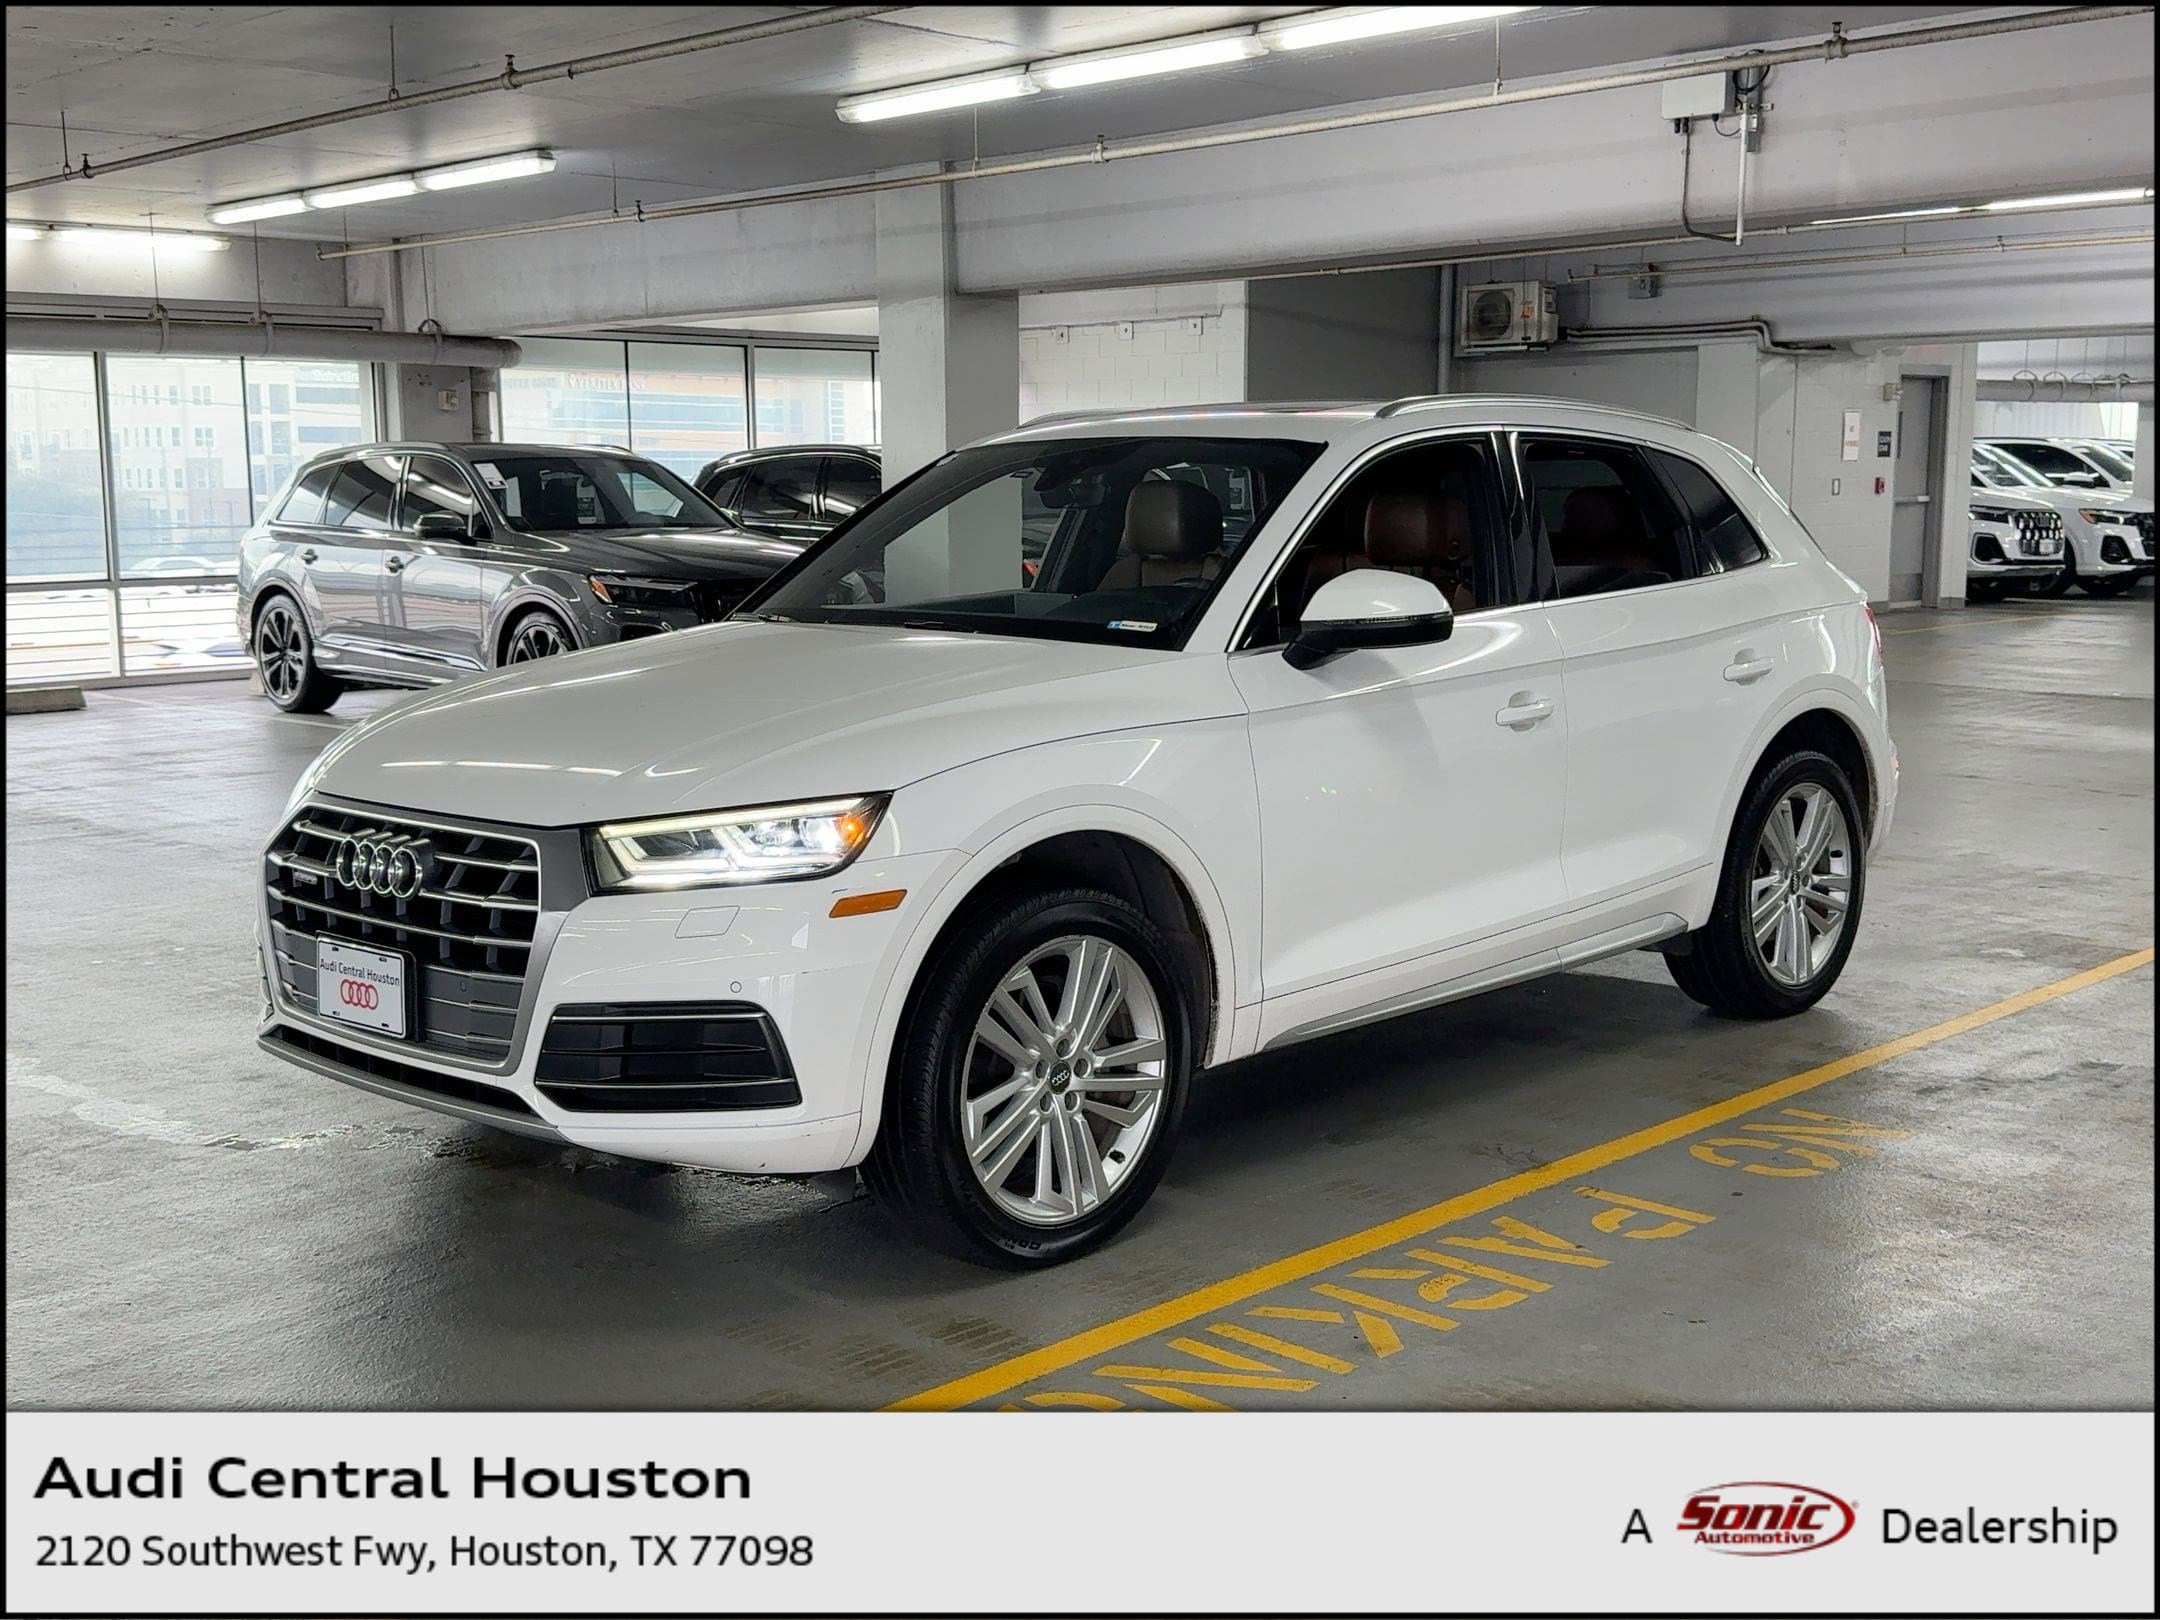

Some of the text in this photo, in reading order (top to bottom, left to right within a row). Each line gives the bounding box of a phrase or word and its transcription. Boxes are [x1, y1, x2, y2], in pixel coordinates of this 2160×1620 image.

[320, 958, 400, 986] Audi Central Houston
[1689, 1107, 1914, 1178] NO
